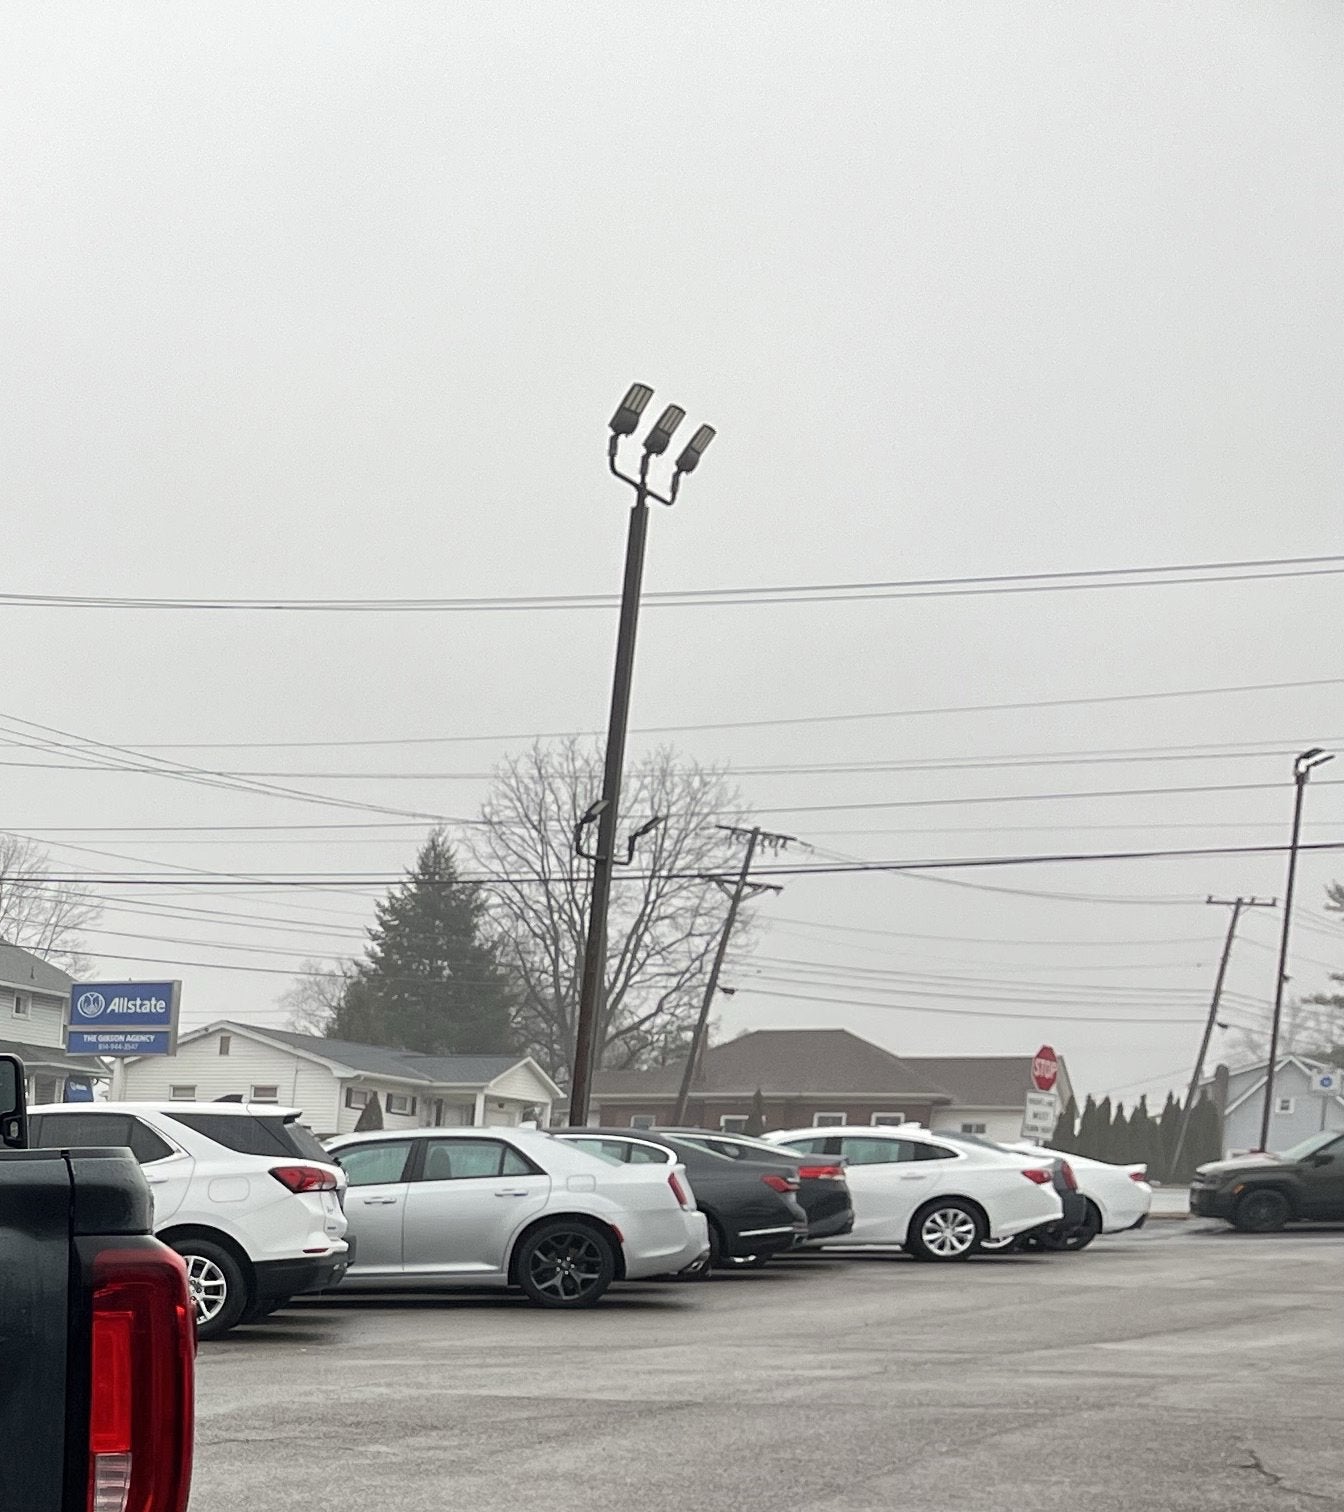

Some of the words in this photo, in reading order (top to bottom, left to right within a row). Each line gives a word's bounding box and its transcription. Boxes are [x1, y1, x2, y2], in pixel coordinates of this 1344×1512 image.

[106, 996, 166, 1014] Allstate
[83, 1034, 97, 1043] THE
[125, 1034, 155, 1043] AGENCY
[1034, 1058, 1058, 1079] STOP
